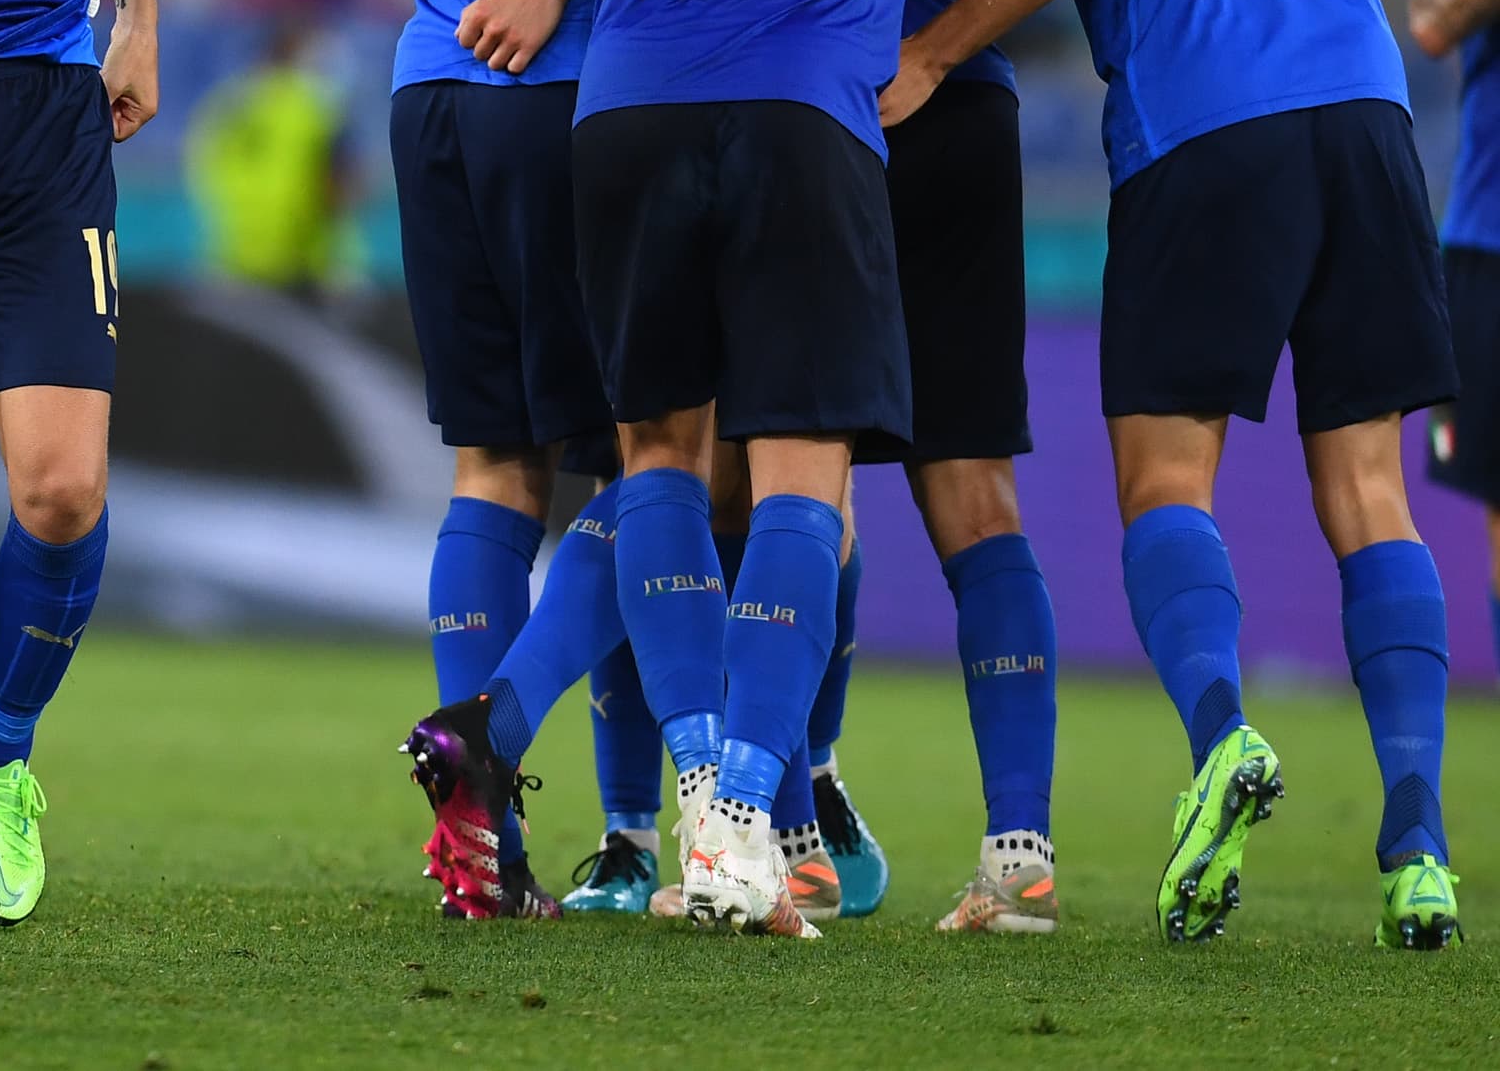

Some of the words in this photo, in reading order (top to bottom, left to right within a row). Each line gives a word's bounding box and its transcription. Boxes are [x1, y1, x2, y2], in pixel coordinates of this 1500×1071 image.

[82, 228, 118, 317] 19
[566, 518, 616, 540] ITALI
[644, 574, 722, 596] ITALIA
[726, 602, 796, 625] ITALIA
[971, 654, 1044, 678] ITALIA
